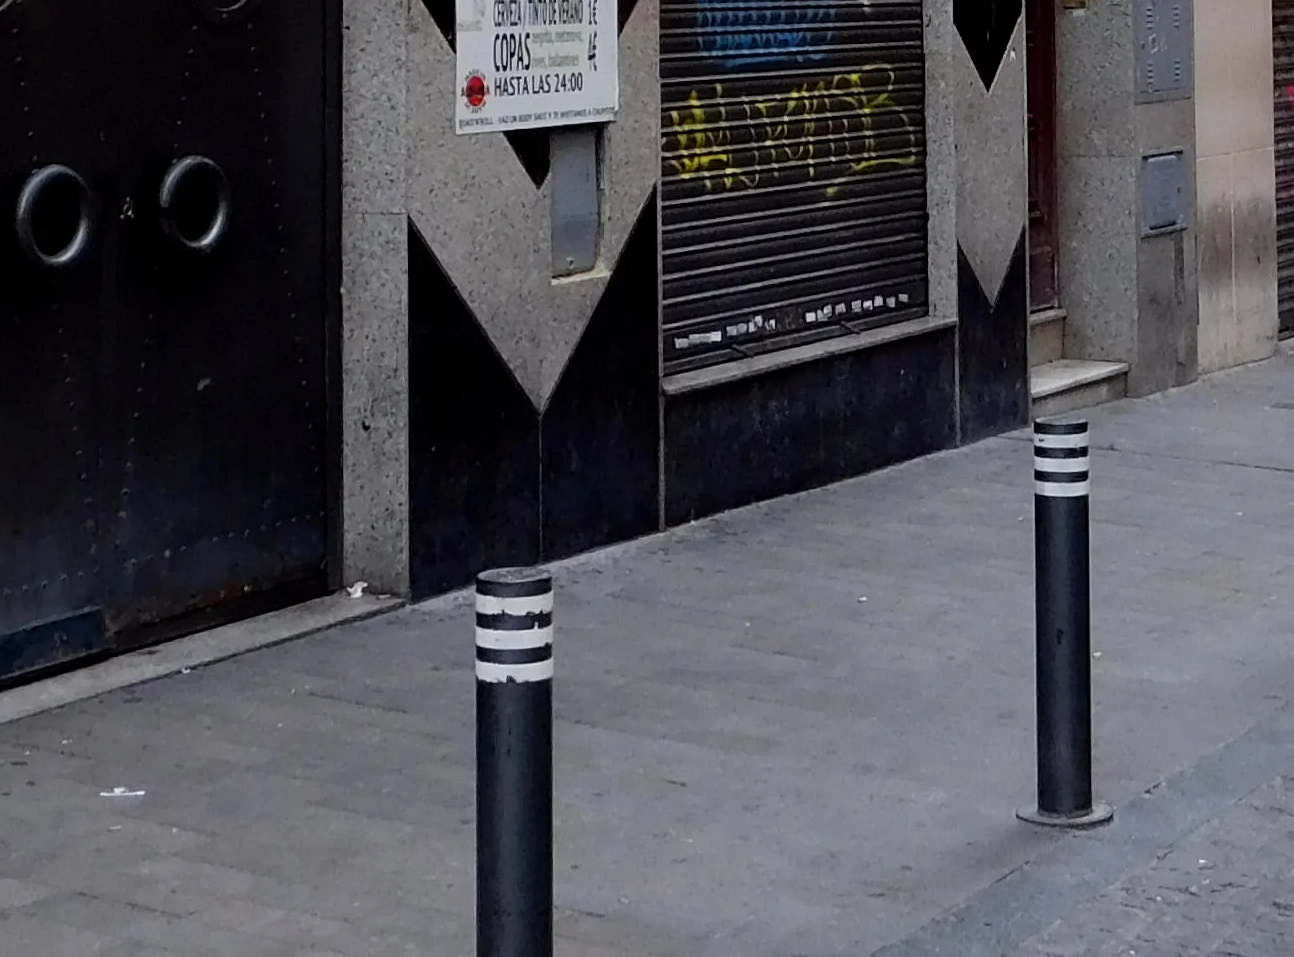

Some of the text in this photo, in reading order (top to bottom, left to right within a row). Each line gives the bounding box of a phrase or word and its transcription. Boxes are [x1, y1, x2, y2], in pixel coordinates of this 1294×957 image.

[493, 0, 522, 27] CERVEZA
[493, 32, 531, 72] COPAS
[494, 76, 530, 97] HASTA
[532, 73, 551, 95] LAS
[554, 71, 584, 94] 24:00
